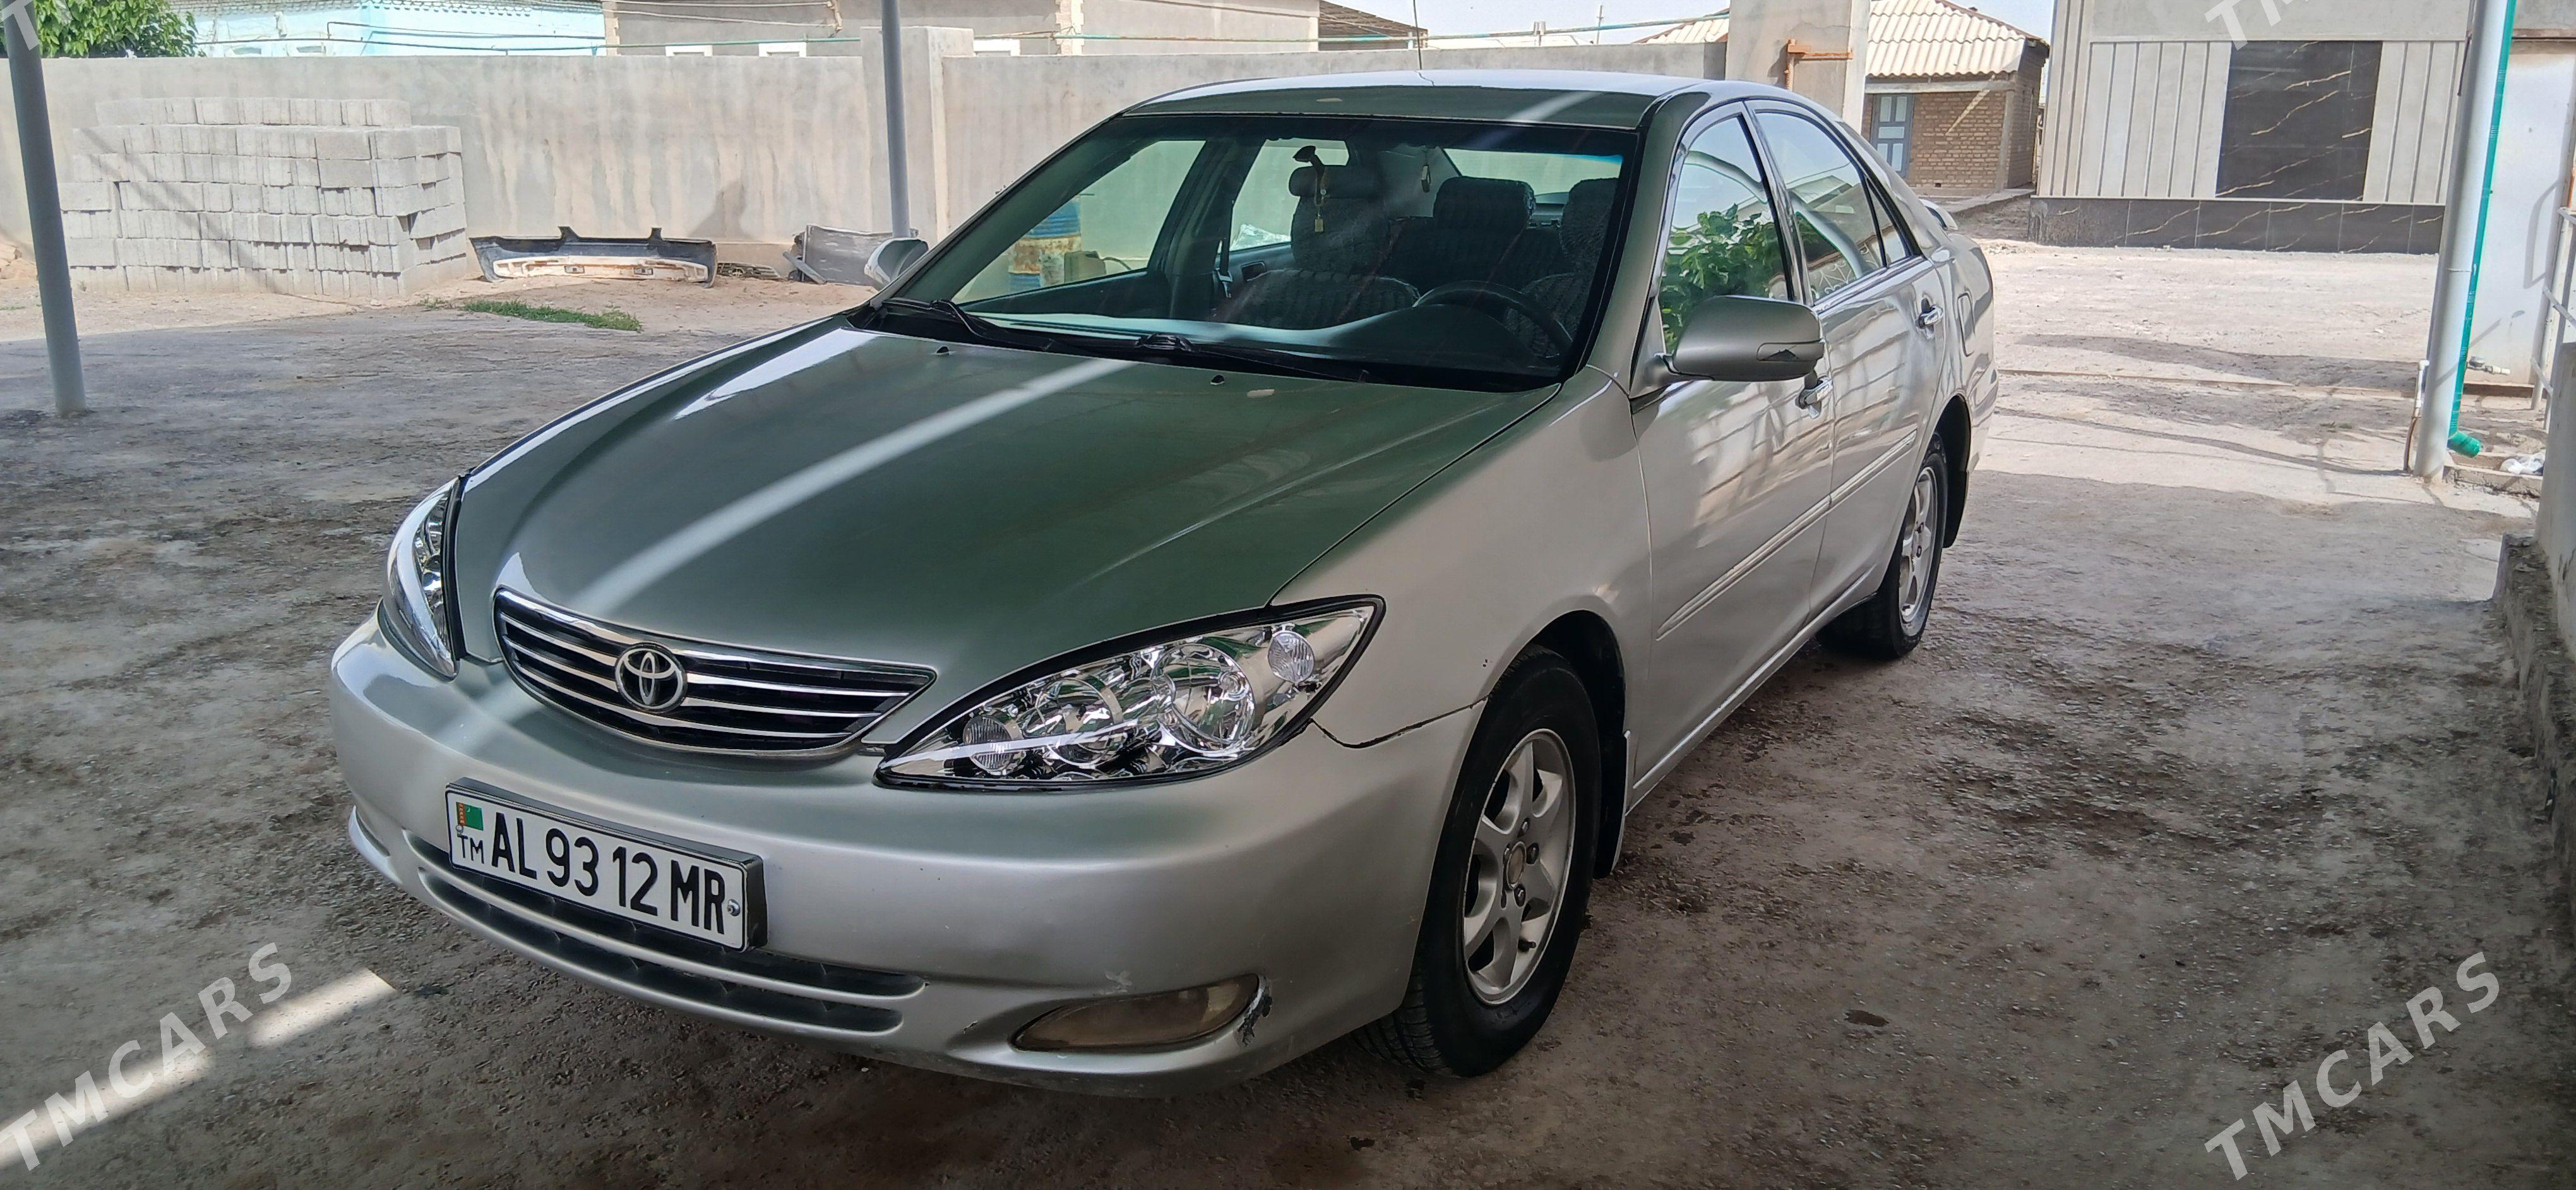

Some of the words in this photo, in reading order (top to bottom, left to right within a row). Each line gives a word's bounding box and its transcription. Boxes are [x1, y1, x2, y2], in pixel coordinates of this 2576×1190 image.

[456, 834, 484, 864] TM
[491, 812, 537, 880] AL
[545, 827, 599, 896] 93
[612, 846, 659, 917] 12
[671, 859, 726, 934] MR
